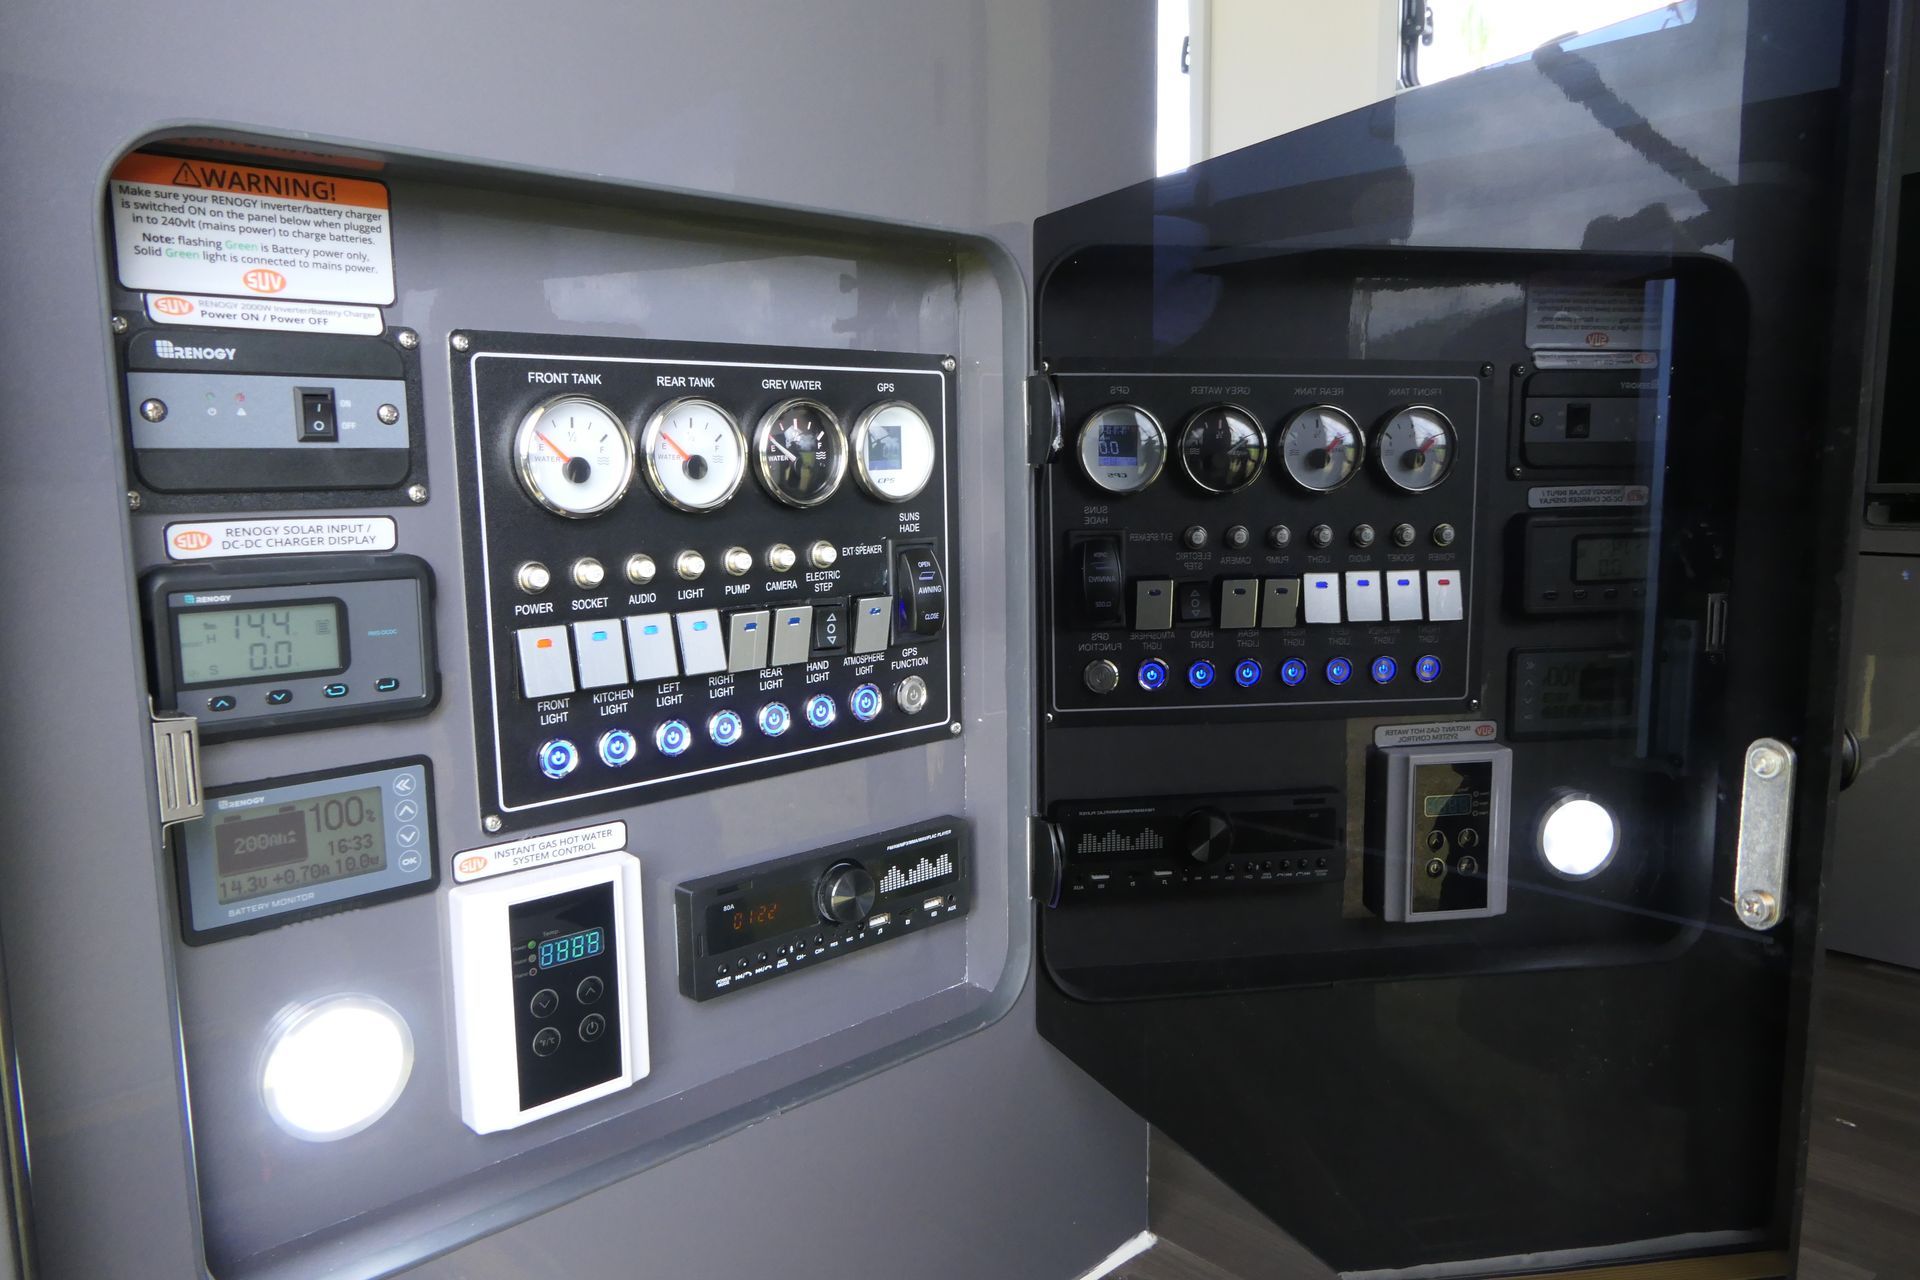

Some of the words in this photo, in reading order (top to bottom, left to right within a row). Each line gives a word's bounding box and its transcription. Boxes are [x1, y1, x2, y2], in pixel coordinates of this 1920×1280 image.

[201, 166, 336, 202] WARNING!
[119, 185, 151, 197] Make
[154, 190, 180, 200] sure
[182, 193, 208, 203] your
[211, 195, 258, 208] RENOGY
[260, 200, 343, 219] inverter/battery
[345, 209, 383, 222] charger
[121, 198, 131, 209] is
[133, 200, 185, 214] switched
[188, 206, 206, 216] ON
[209, 209, 224, 218] on
[226, 209, 245, 220] the
[247, 213, 277, 224] panel
[280, 215, 311, 226] below
[314, 219, 342, 230] when
[344, 222, 382, 234] plugged
[132, 213, 143, 223] in
[146, 215, 159, 225] to
[161, 216, 196, 228] 240vlt
[198, 219, 236, 232] (mains
[238, 225, 277, 237] power)
[278, 228, 289, 237] to
[292, 229, 327, 242] charge
[329, 231, 376, 246] batteries.
[142, 232, 175, 244] Note:
[178, 235, 222, 251] flashing
[225, 240, 258, 251] Green
[261, 243, 269, 253] is
[272, 244, 310, 257] Battery
[313, 248, 344, 259] power
[133, 245, 162, 256] Solid
[165, 248, 200, 259] Green
[203, 251, 227, 263] light
[230, 254, 239, 263] is
[241, 255, 296, 267] connected
[298, 260, 309, 268] to
[312, 261, 342, 271] mains
[345, 264, 379, 274] power.
[247, 272, 282, 290] SUV
[157, 300, 191, 314] SUV
[198, 300, 238, 309] RENOGY
[241, 302, 272, 311] 2000W
[343, 309, 375, 319] Charger
[200, 310, 237, 320] Power
[242, 313, 259, 322] ON
[270, 314, 304, 324] Power
[308, 317, 328, 326] OFF
[174, 347, 236, 361] RENOGY
[527, 372, 569, 384] FRONT
[572, 373, 602, 385] TANK
[657, 376, 687, 387] REAR
[688, 377, 715, 388] TANK
[762, 379, 788, 390] GREY
[790, 380, 822, 390] WATER
[877, 383, 895, 393] GPS
[538, 443, 544, 451] E
[899, 512, 920, 522] SUNS
[225, 526, 279, 538] RENOGY
[283, 525, 324, 535] SOLAR
[327, 524, 363, 534] INPUT
[900, 523, 920, 533] HADE
[176, 533, 210, 549] SUV
[222, 538, 262, 550] DC-DC
[266, 536, 324, 548] CHARGER
[328, 535, 376, 546] DISPLAY
[842, 547, 854, 556] EXT
[855, 545, 882, 556] SPEAKER
[805, 570, 841, 582] ELECTRIC
[725, 584, 750, 595] PUMP
[766, 580, 798, 592] CAMERA
[814, 583, 833, 593] STEP
[918, 585, 942, 595] AWNING
[195, 594, 231, 604] RENOGY
[629, 593, 656, 605] AUDIO
[678, 588, 704, 600] LIGHT
[515, 603, 553, 616] POWER
[572, 597, 609, 611] SOCKET
[235, 612, 290, 639] 14.4
[249, 641, 292, 671] 0.0
[843, 653, 885, 666] ATMOSPHERE
[902, 648, 918, 658] GPS
[806, 661, 829, 672] HAND
[891, 657, 929, 670] FUNCTION
[760, 667, 783, 679] REAR
[855, 665, 874, 676] LIGHT
[708, 674, 735, 686] RIGHT
[806, 672, 830, 684] LIGHT
[658, 682, 680, 694] LEFT
[760, 679, 783, 691] LIGHT
[593, 689, 634, 704] KITCHEN
[709, 686, 735, 699] LIGHT
[537, 698, 570, 712] FRONT
[656, 694, 683, 707] LIGHT
[600, 703, 628, 716] LIGHT
[540, 712, 569, 726] LIGHT
[229, 796, 265, 807] RENOGY
[234, 833, 287, 855] 200Ah
[328, 834, 374, 856] 16:33
[494, 843, 537, 860] INSTANT
[538, 838, 557, 851] GAS
[560, 835, 581, 848] HOT
[582, 828, 613, 843] WATER
[513, 851, 550, 866] SYSTEM
[552, 841, 596, 859] CONTROL
[401, 857, 417, 866] OK
[461, 858, 485, 872] SUV
[228, 902, 270, 917] BATTERY
[272, 892, 315, 908] MONITOR
[723, 904, 734, 912] 80A
[716, 976, 731, 985] POWER
